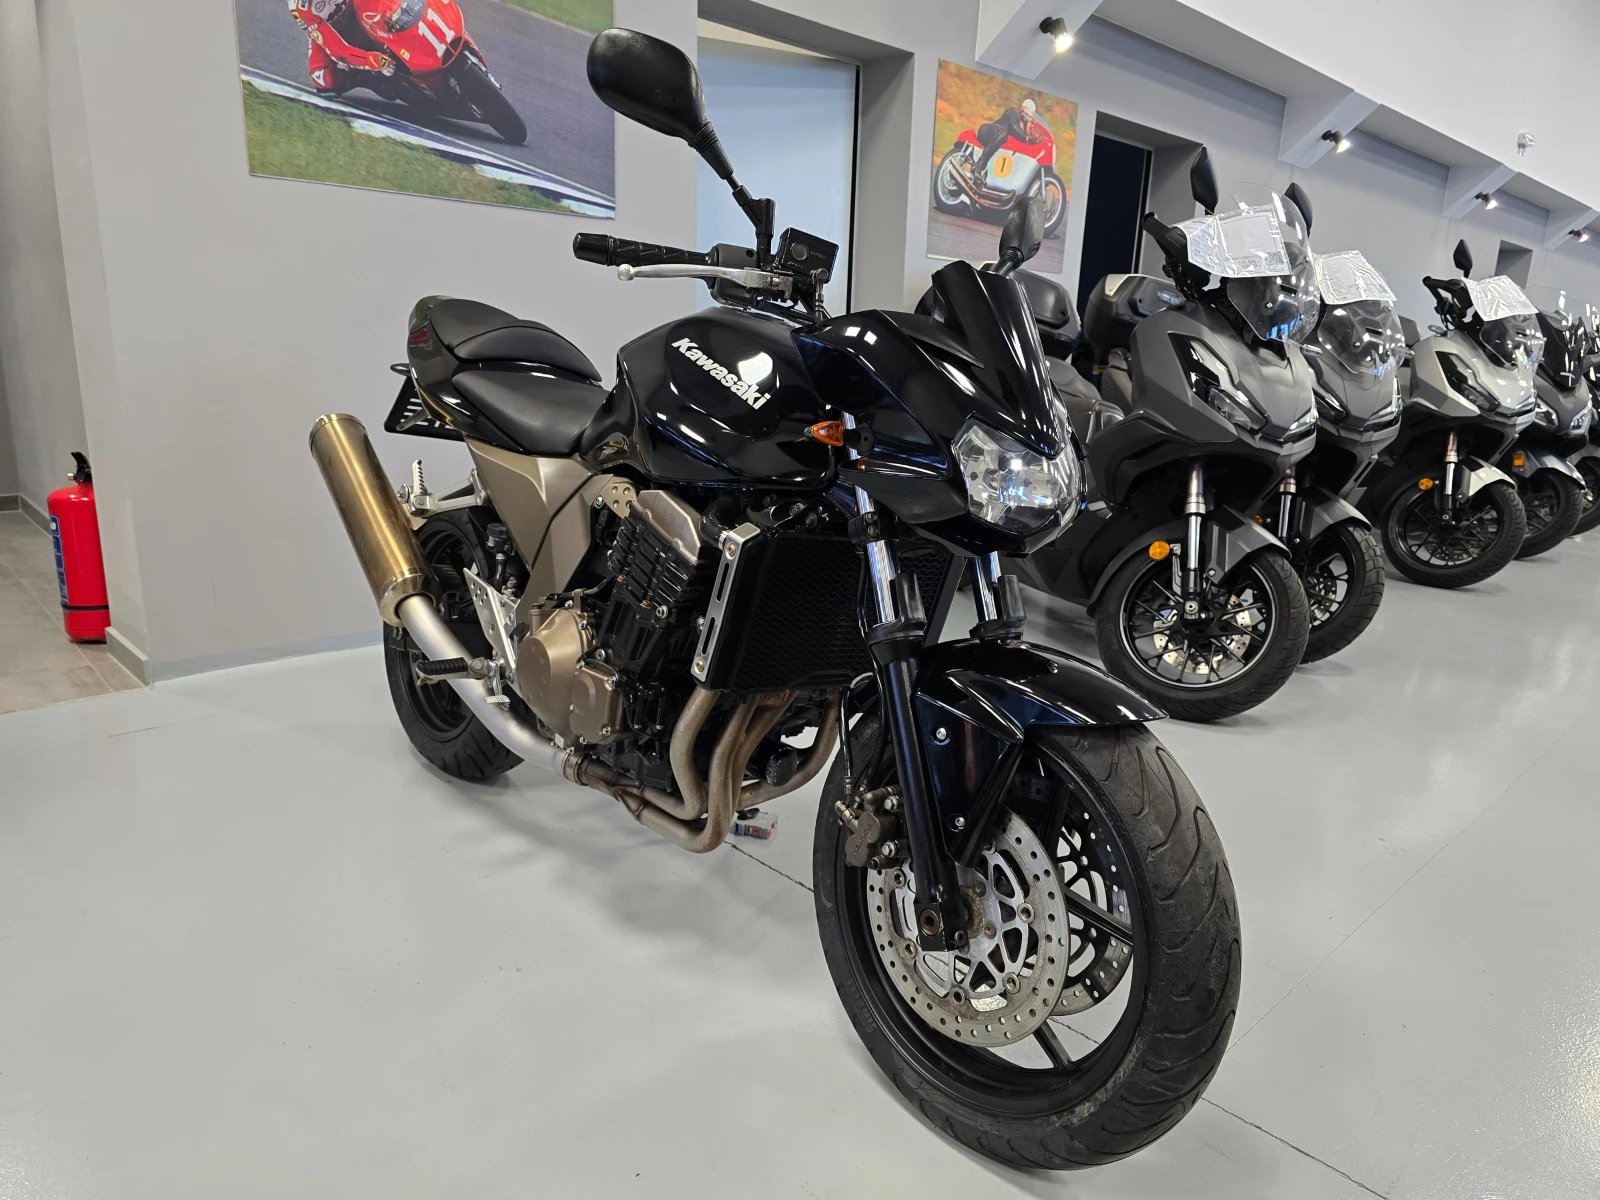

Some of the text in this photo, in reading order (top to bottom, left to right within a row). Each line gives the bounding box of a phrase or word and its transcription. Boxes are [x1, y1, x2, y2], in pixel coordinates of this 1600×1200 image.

[418, 8, 455, 58] 11
[1000, 157, 1007, 173] 1
[671, 337, 772, 410] Kawasaki
